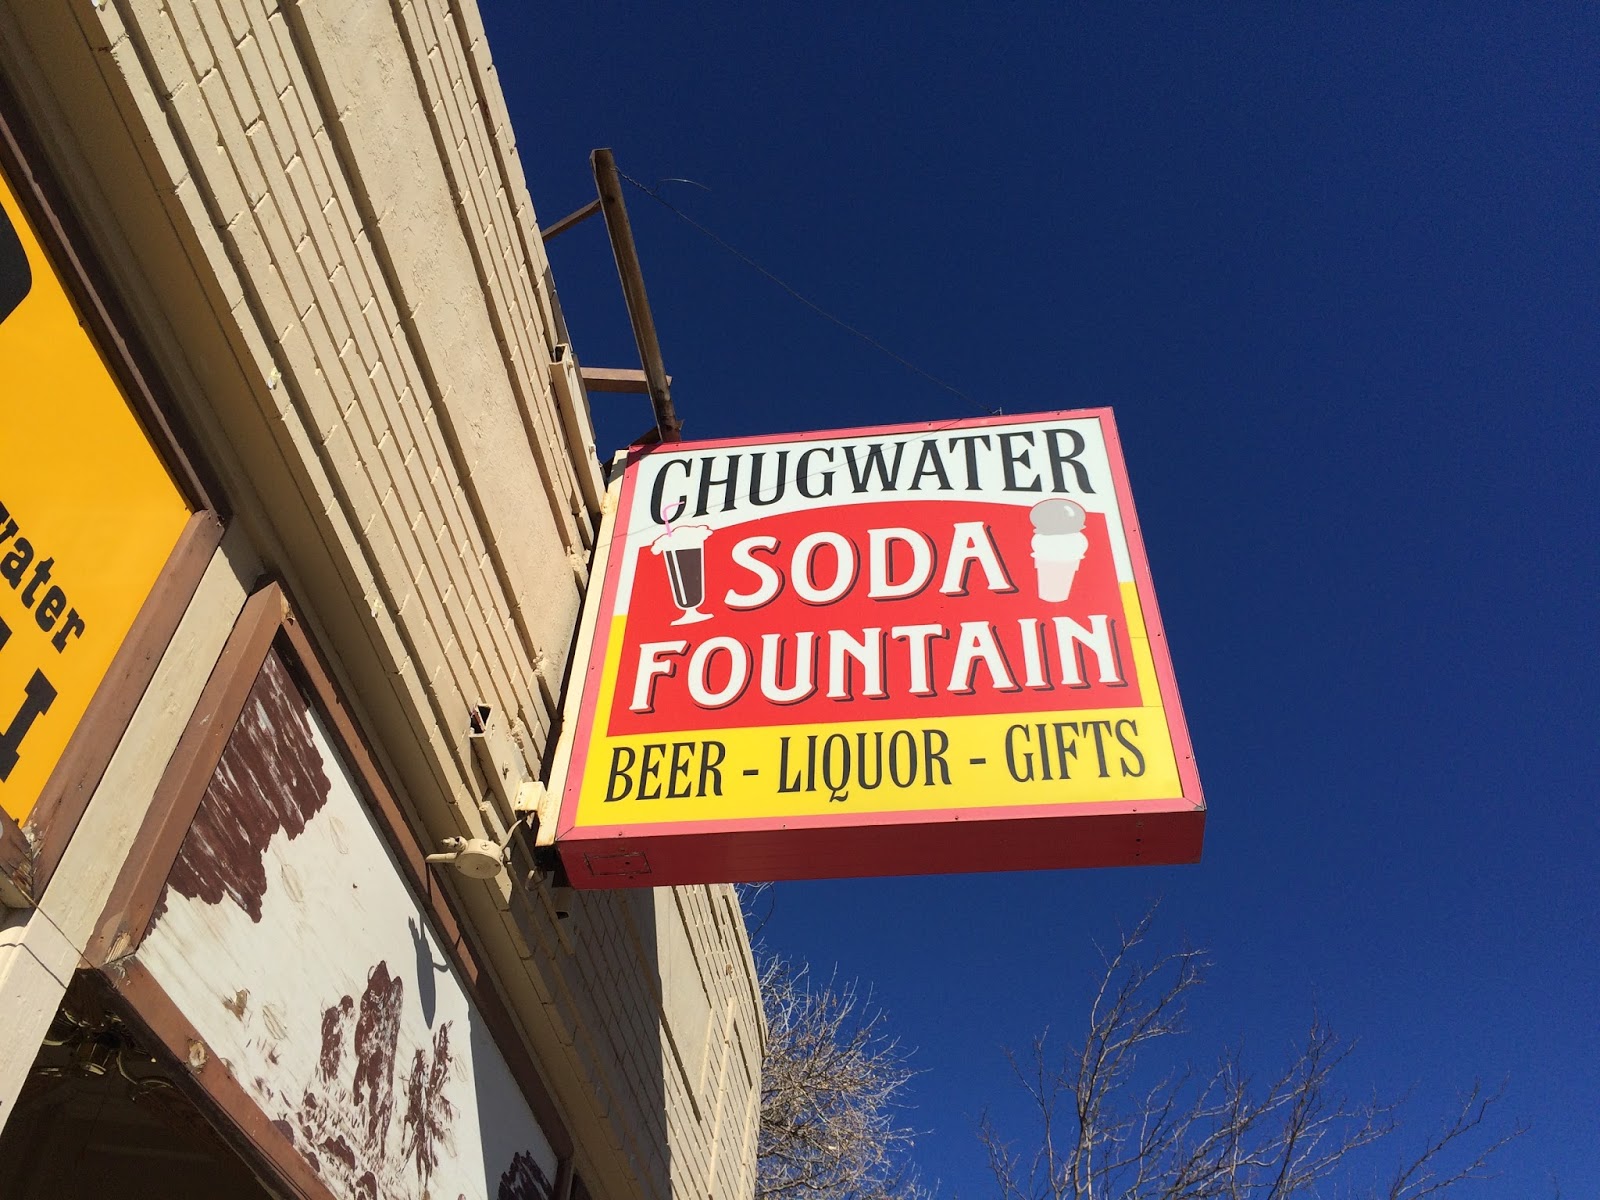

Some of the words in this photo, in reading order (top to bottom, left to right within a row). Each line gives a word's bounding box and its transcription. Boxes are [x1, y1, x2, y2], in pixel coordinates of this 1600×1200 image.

[650, 429, 1096, 525] CHUGWATER
[724, 521, 1018, 611] SODA
[628, 613, 1128, 714] FOUNTAIN
[603, 741, 727, 803] BEER
[776, 729, 952, 803] LIQUOR
[1004, 719, 1148, 783] GIFTS
